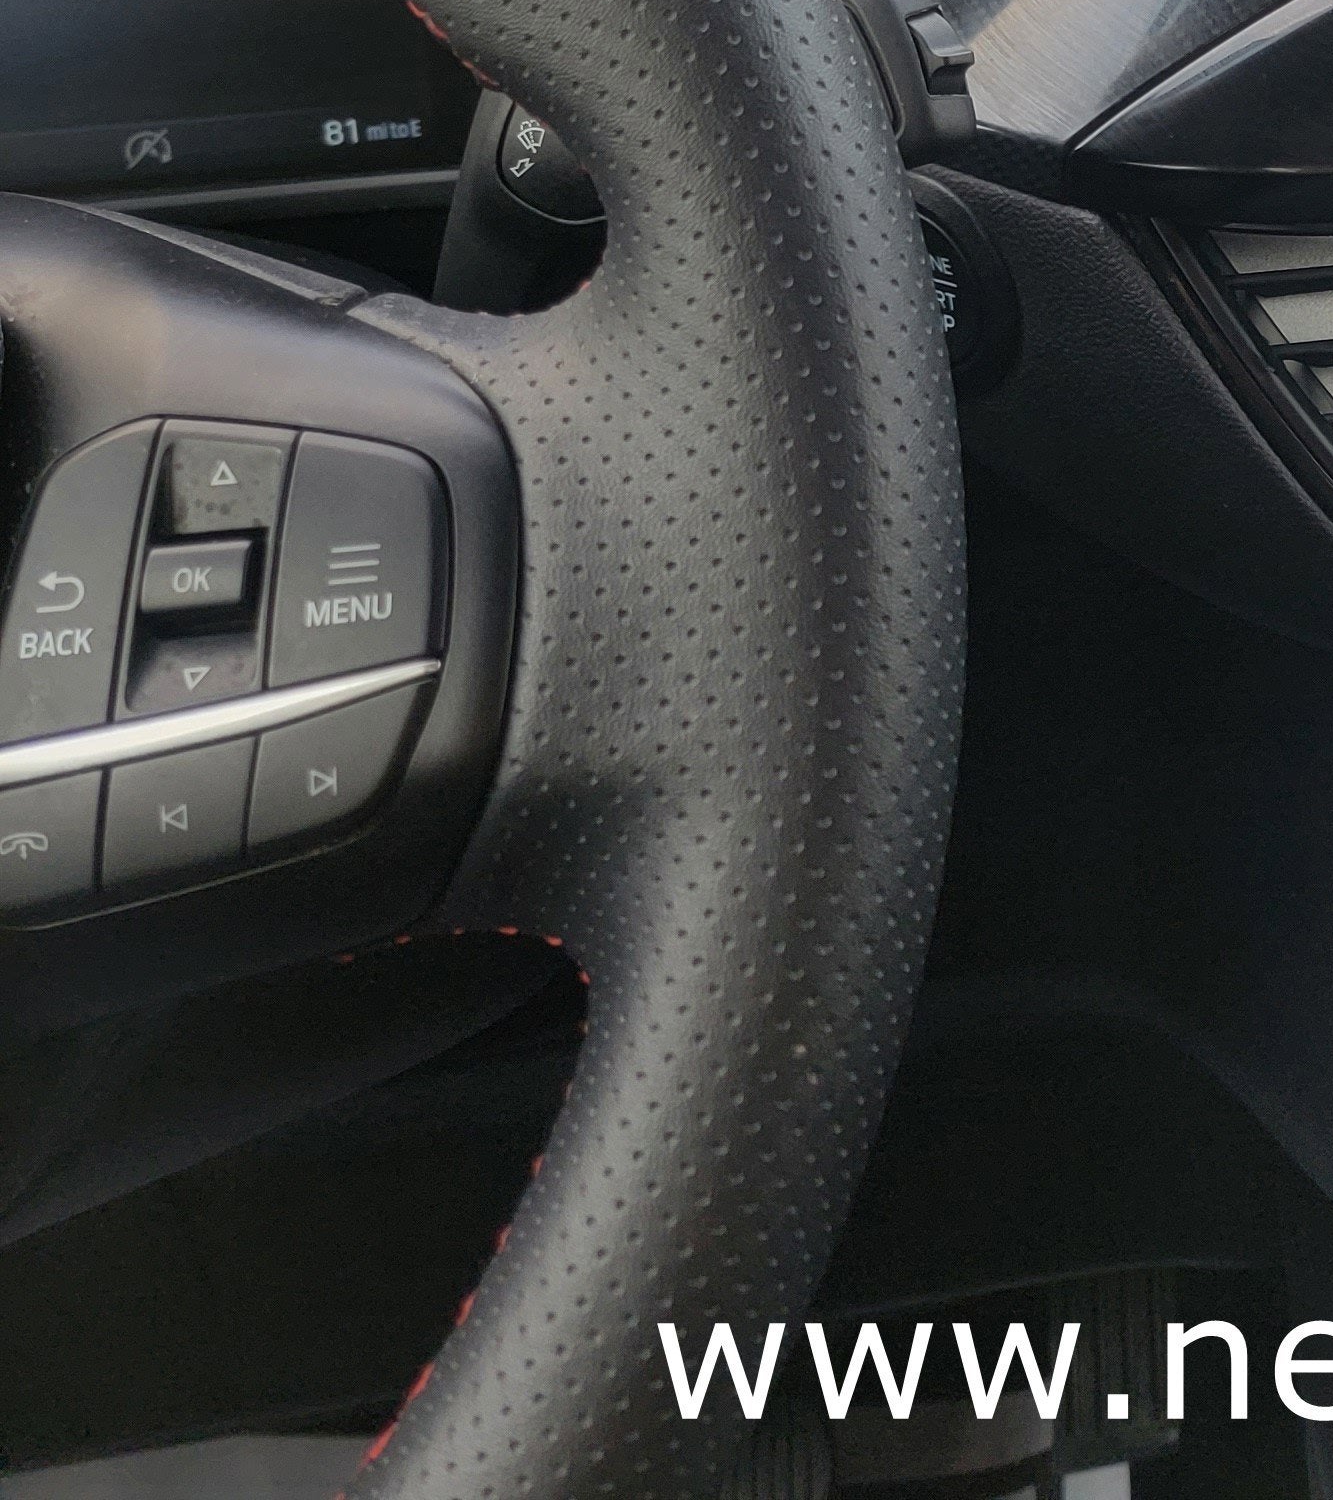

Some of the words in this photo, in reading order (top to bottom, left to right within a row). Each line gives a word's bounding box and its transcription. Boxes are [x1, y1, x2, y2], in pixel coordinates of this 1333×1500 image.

[323, 117, 360, 147] 81
[171, 566, 212, 594] OK
[304, 591, 393, 628] MENU
[19, 628, 95, 660] BACK
